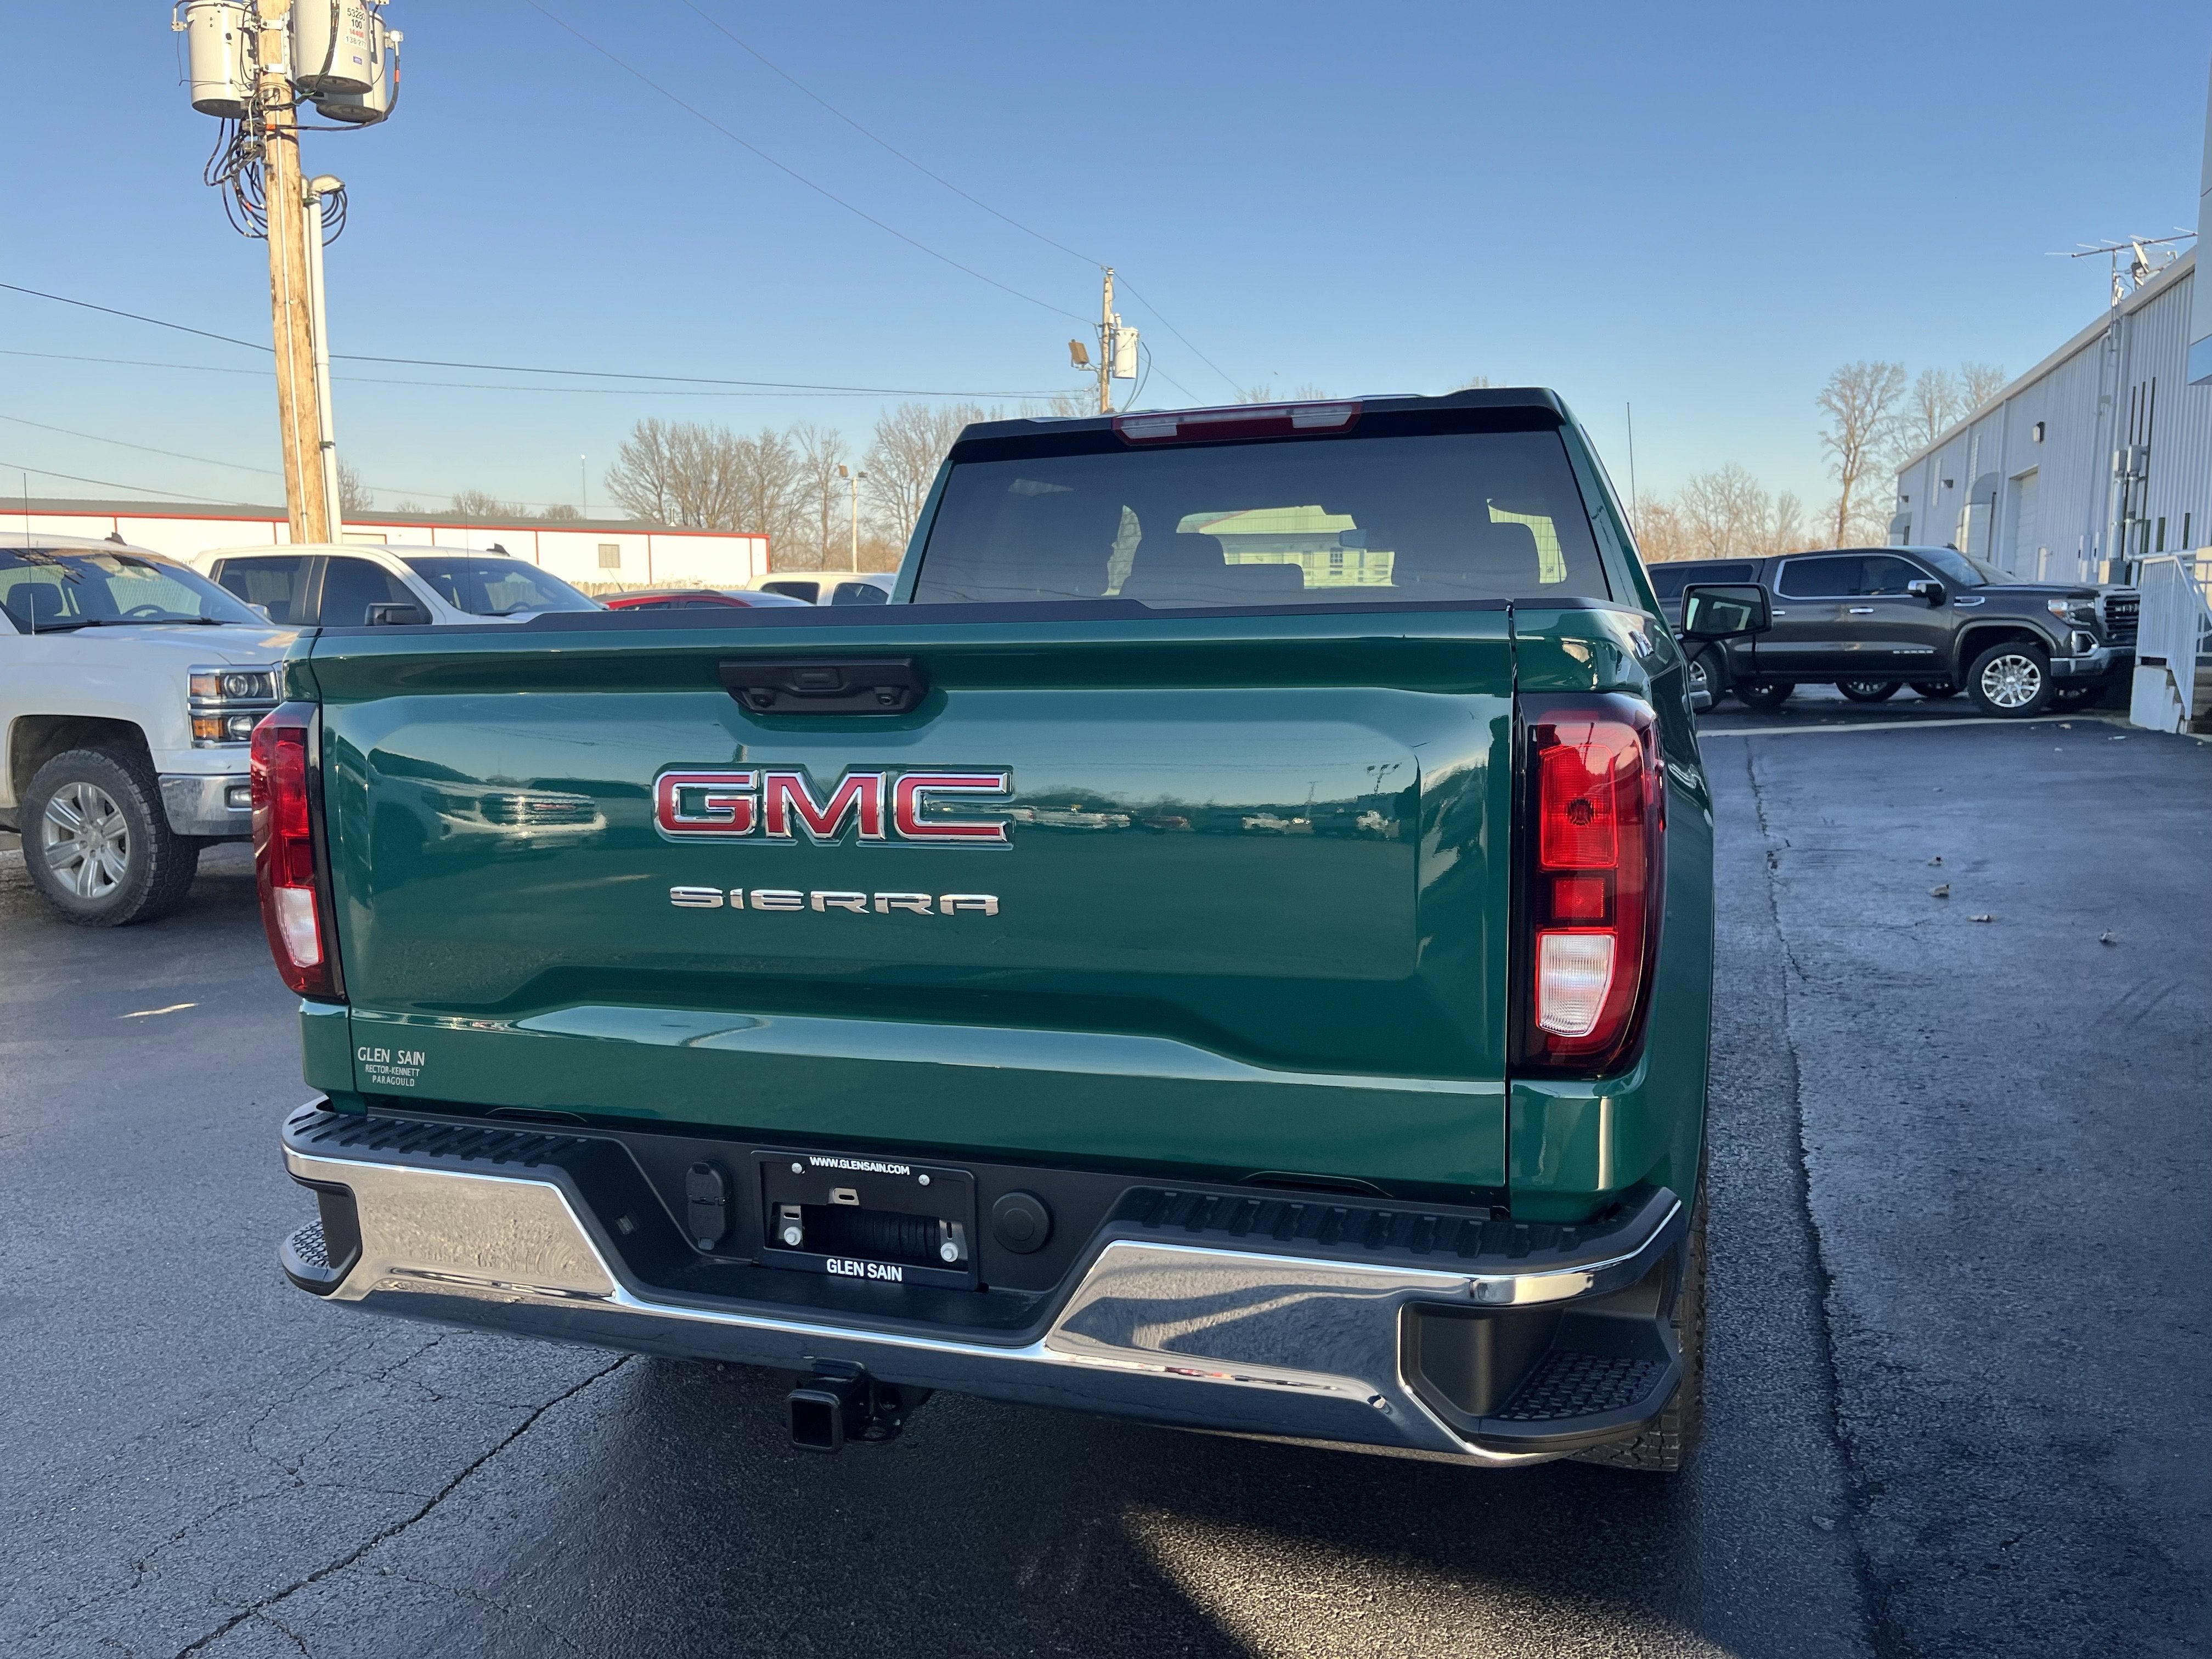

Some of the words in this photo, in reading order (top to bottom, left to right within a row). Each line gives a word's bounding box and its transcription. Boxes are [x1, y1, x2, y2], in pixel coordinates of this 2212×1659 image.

[351, 19, 362, 29] 100
[654, 769, 1008, 843] GMC
[669, 886, 1000, 917] SIERRA
[357, 1046, 390, 1063] GLEN
[397, 1049, 425, 1066] SAIN
[365, 1064, 420, 1077] RECTOR-KENNETT
[372, 1075, 415, 1087] PARAGOULD
[809, 1156, 910, 1176] WWW.GLENSAIN.COM
[826, 1258, 865, 1277] GLEN
[867, 1262, 902, 1282] SAIN
